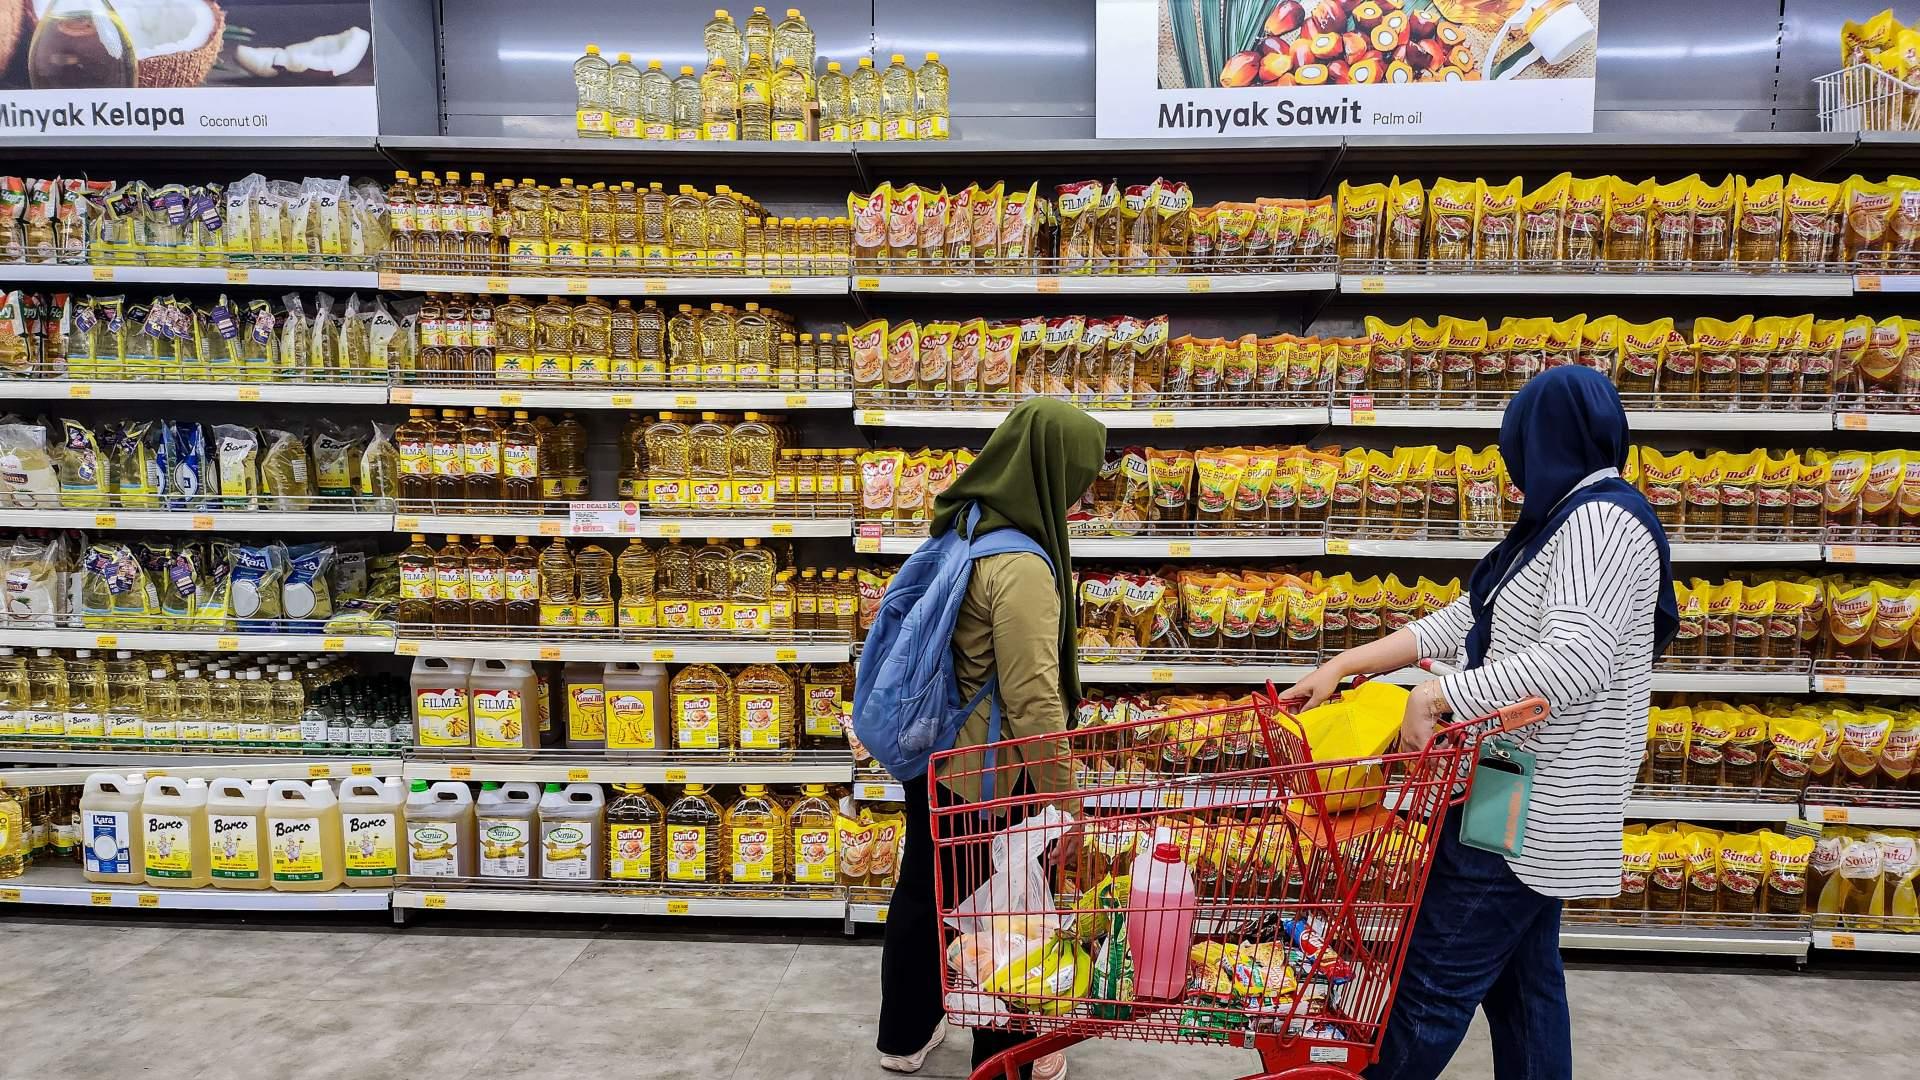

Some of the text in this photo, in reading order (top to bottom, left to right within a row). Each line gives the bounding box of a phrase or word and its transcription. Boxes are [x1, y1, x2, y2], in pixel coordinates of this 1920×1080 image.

[91, 102, 185, 130] Kelapa
[1158, 98, 1362, 133] Minyak Sawit
[1373, 112, 1422, 125] Palm oil
[200, 115, 268, 128] Coconut Oil
[1434, 198, 1474, 210] Bimoli
[1644, 463, 1682, 478] Bimoli
[655, 484, 678, 494] SunCo
[695, 485, 718, 494] SunCo
[739, 485, 762, 494] SunCo
[1085, 583, 1118, 598] FILMA
[664, 604, 688, 614] SunCo
[700, 607, 722, 617] SunCo
[734, 610, 757, 619] SunCo
[594, 694, 604, 702] Ma
[811, 689, 835, 698] SunCo
[422, 696, 462, 708] FILMA
[478, 697, 515, 710] FILMA
[684, 700, 709, 710] SunCo
[746, 700, 771, 710] SunCo
[72, 716, 91, 724] Barco
[116, 717, 135, 726] Barco
[149, 818, 183, 832] Barco
[214, 819, 248, 833] Barco
[275, 822, 311, 836] Barco
[350, 818, 387, 832] Barco
[420, 831, 442, 841] Sania
[493, 827, 515, 839] Sania
[555, 830, 577, 841] Sania
[618, 831, 642, 841] SunCo
[674, 832, 697, 842] SunCo
[740, 833, 765, 844] SunCo
[802, 835, 827, 845] SunCo
